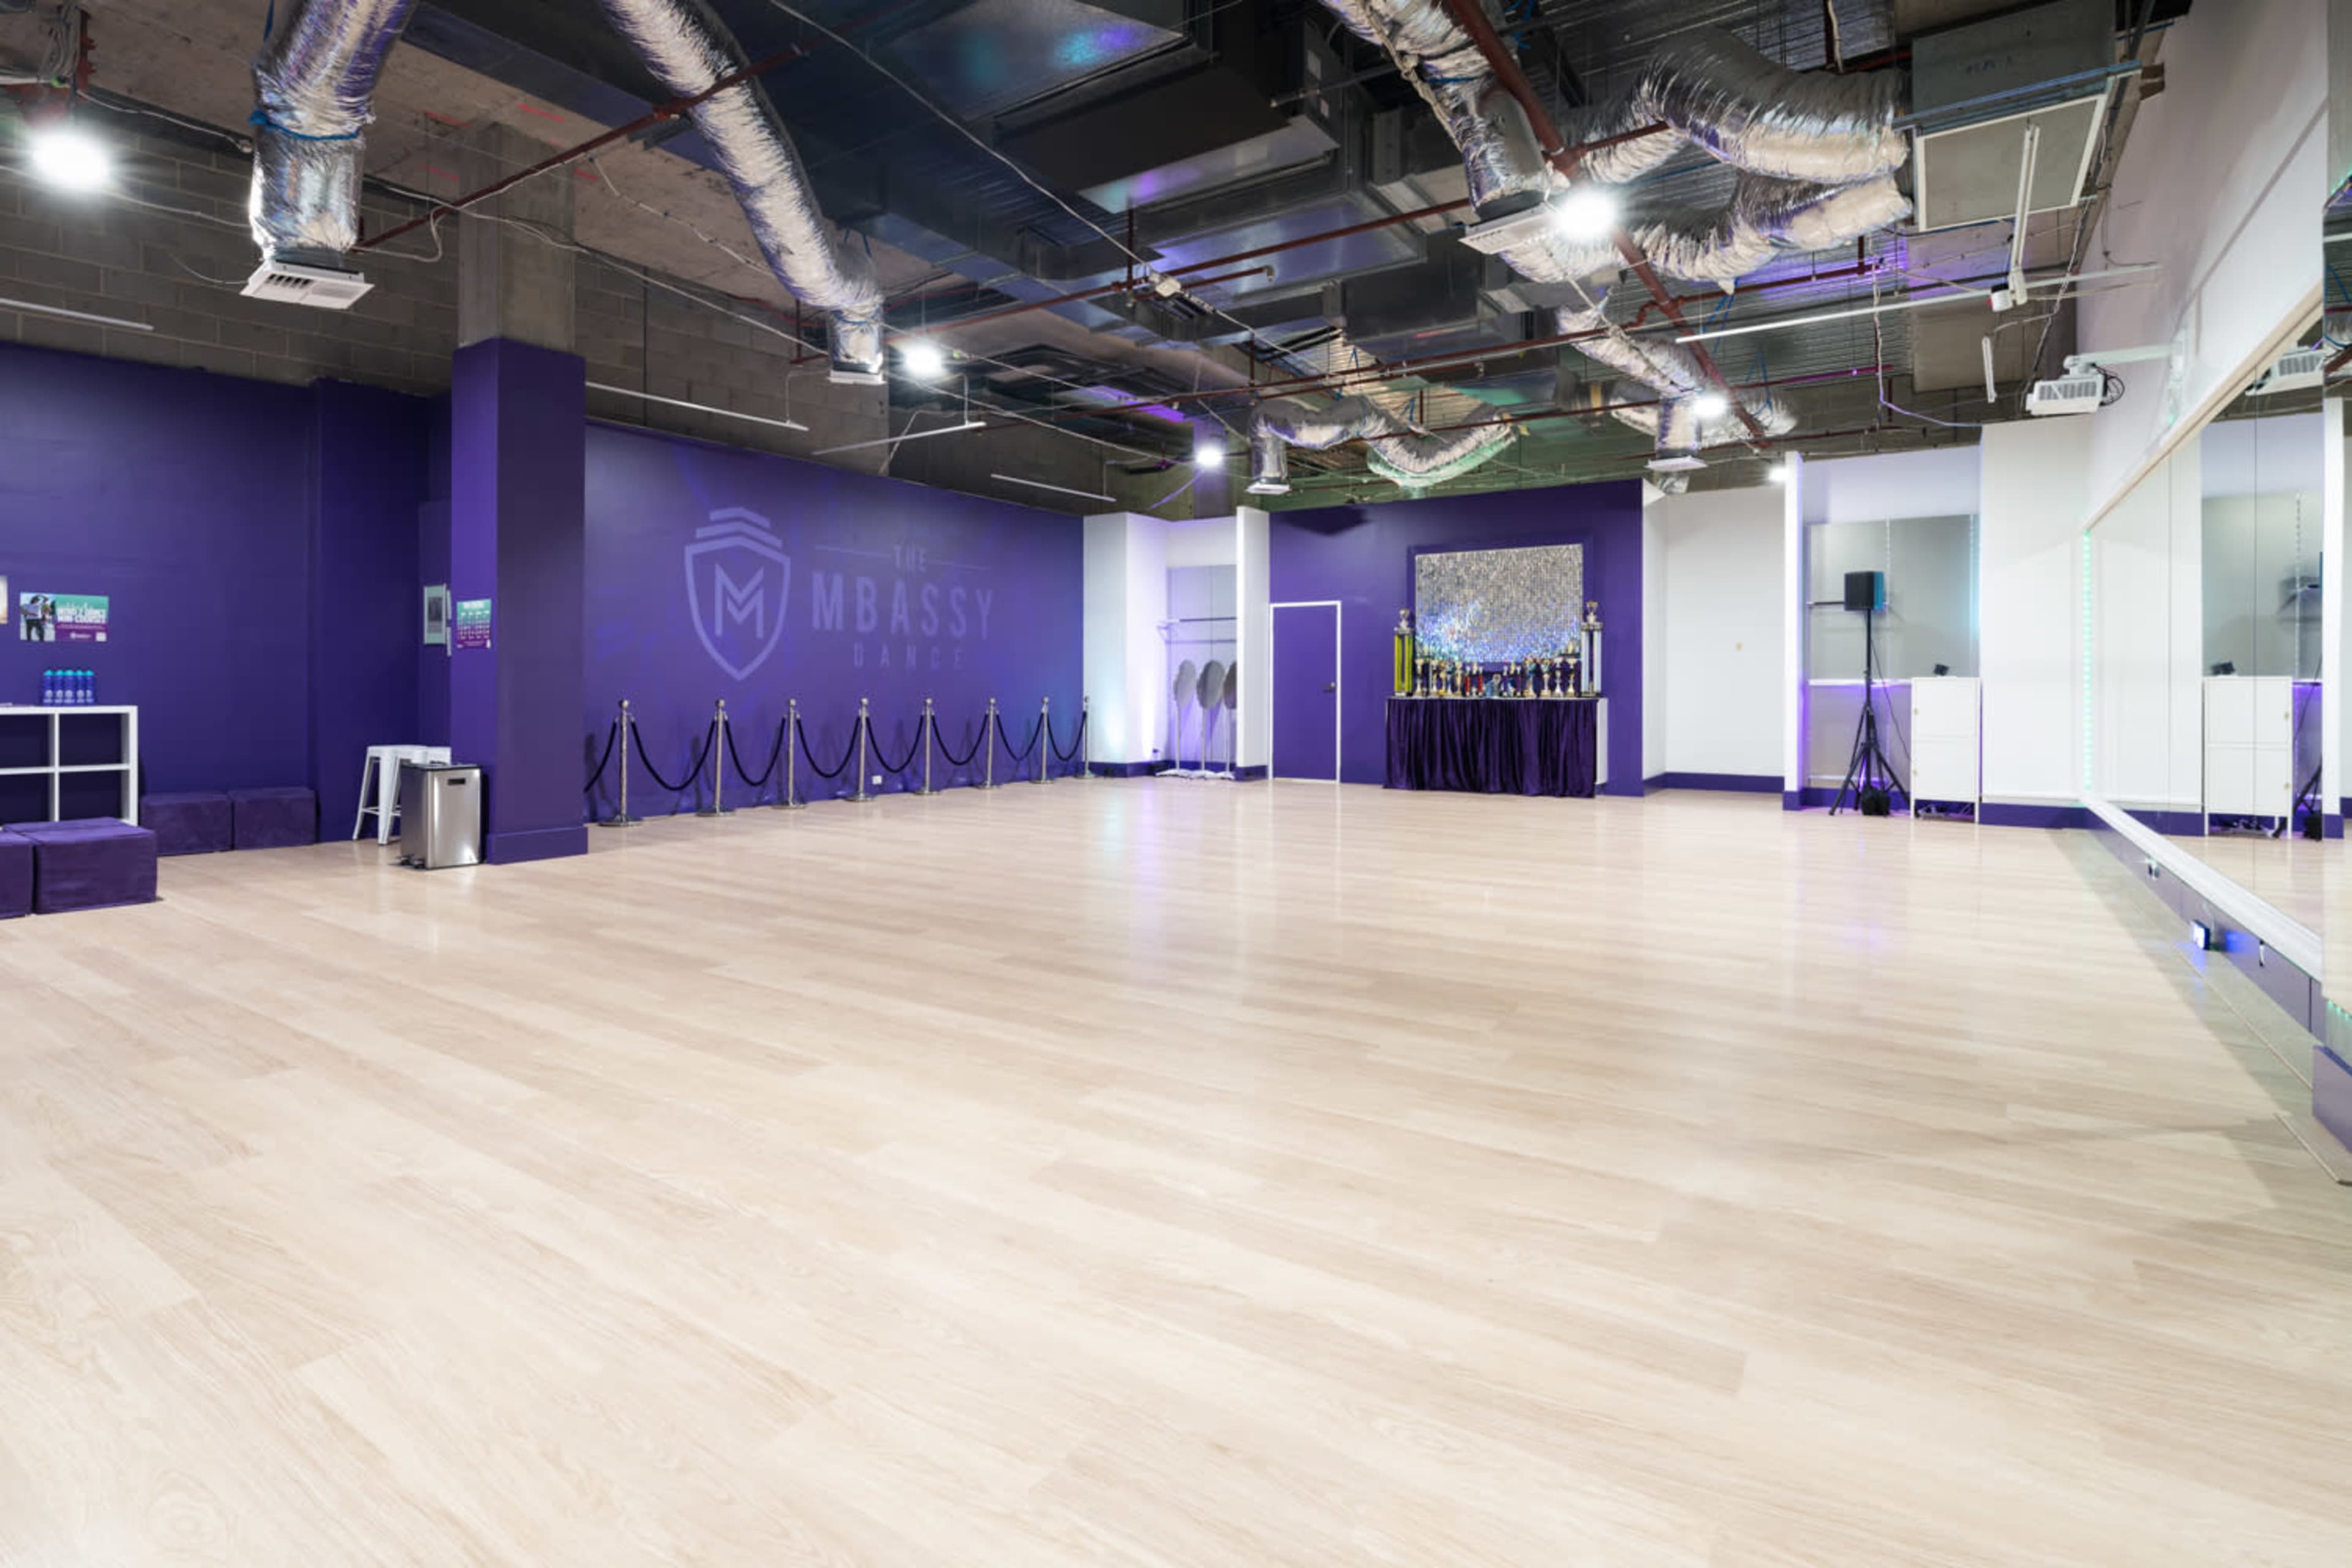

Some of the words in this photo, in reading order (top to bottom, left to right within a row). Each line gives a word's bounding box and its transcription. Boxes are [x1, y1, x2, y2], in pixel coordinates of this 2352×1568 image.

[894, 545, 927, 573] THE
[812, 572, 993, 640] MBASSY
[854, 642, 965, 670] DANCE
